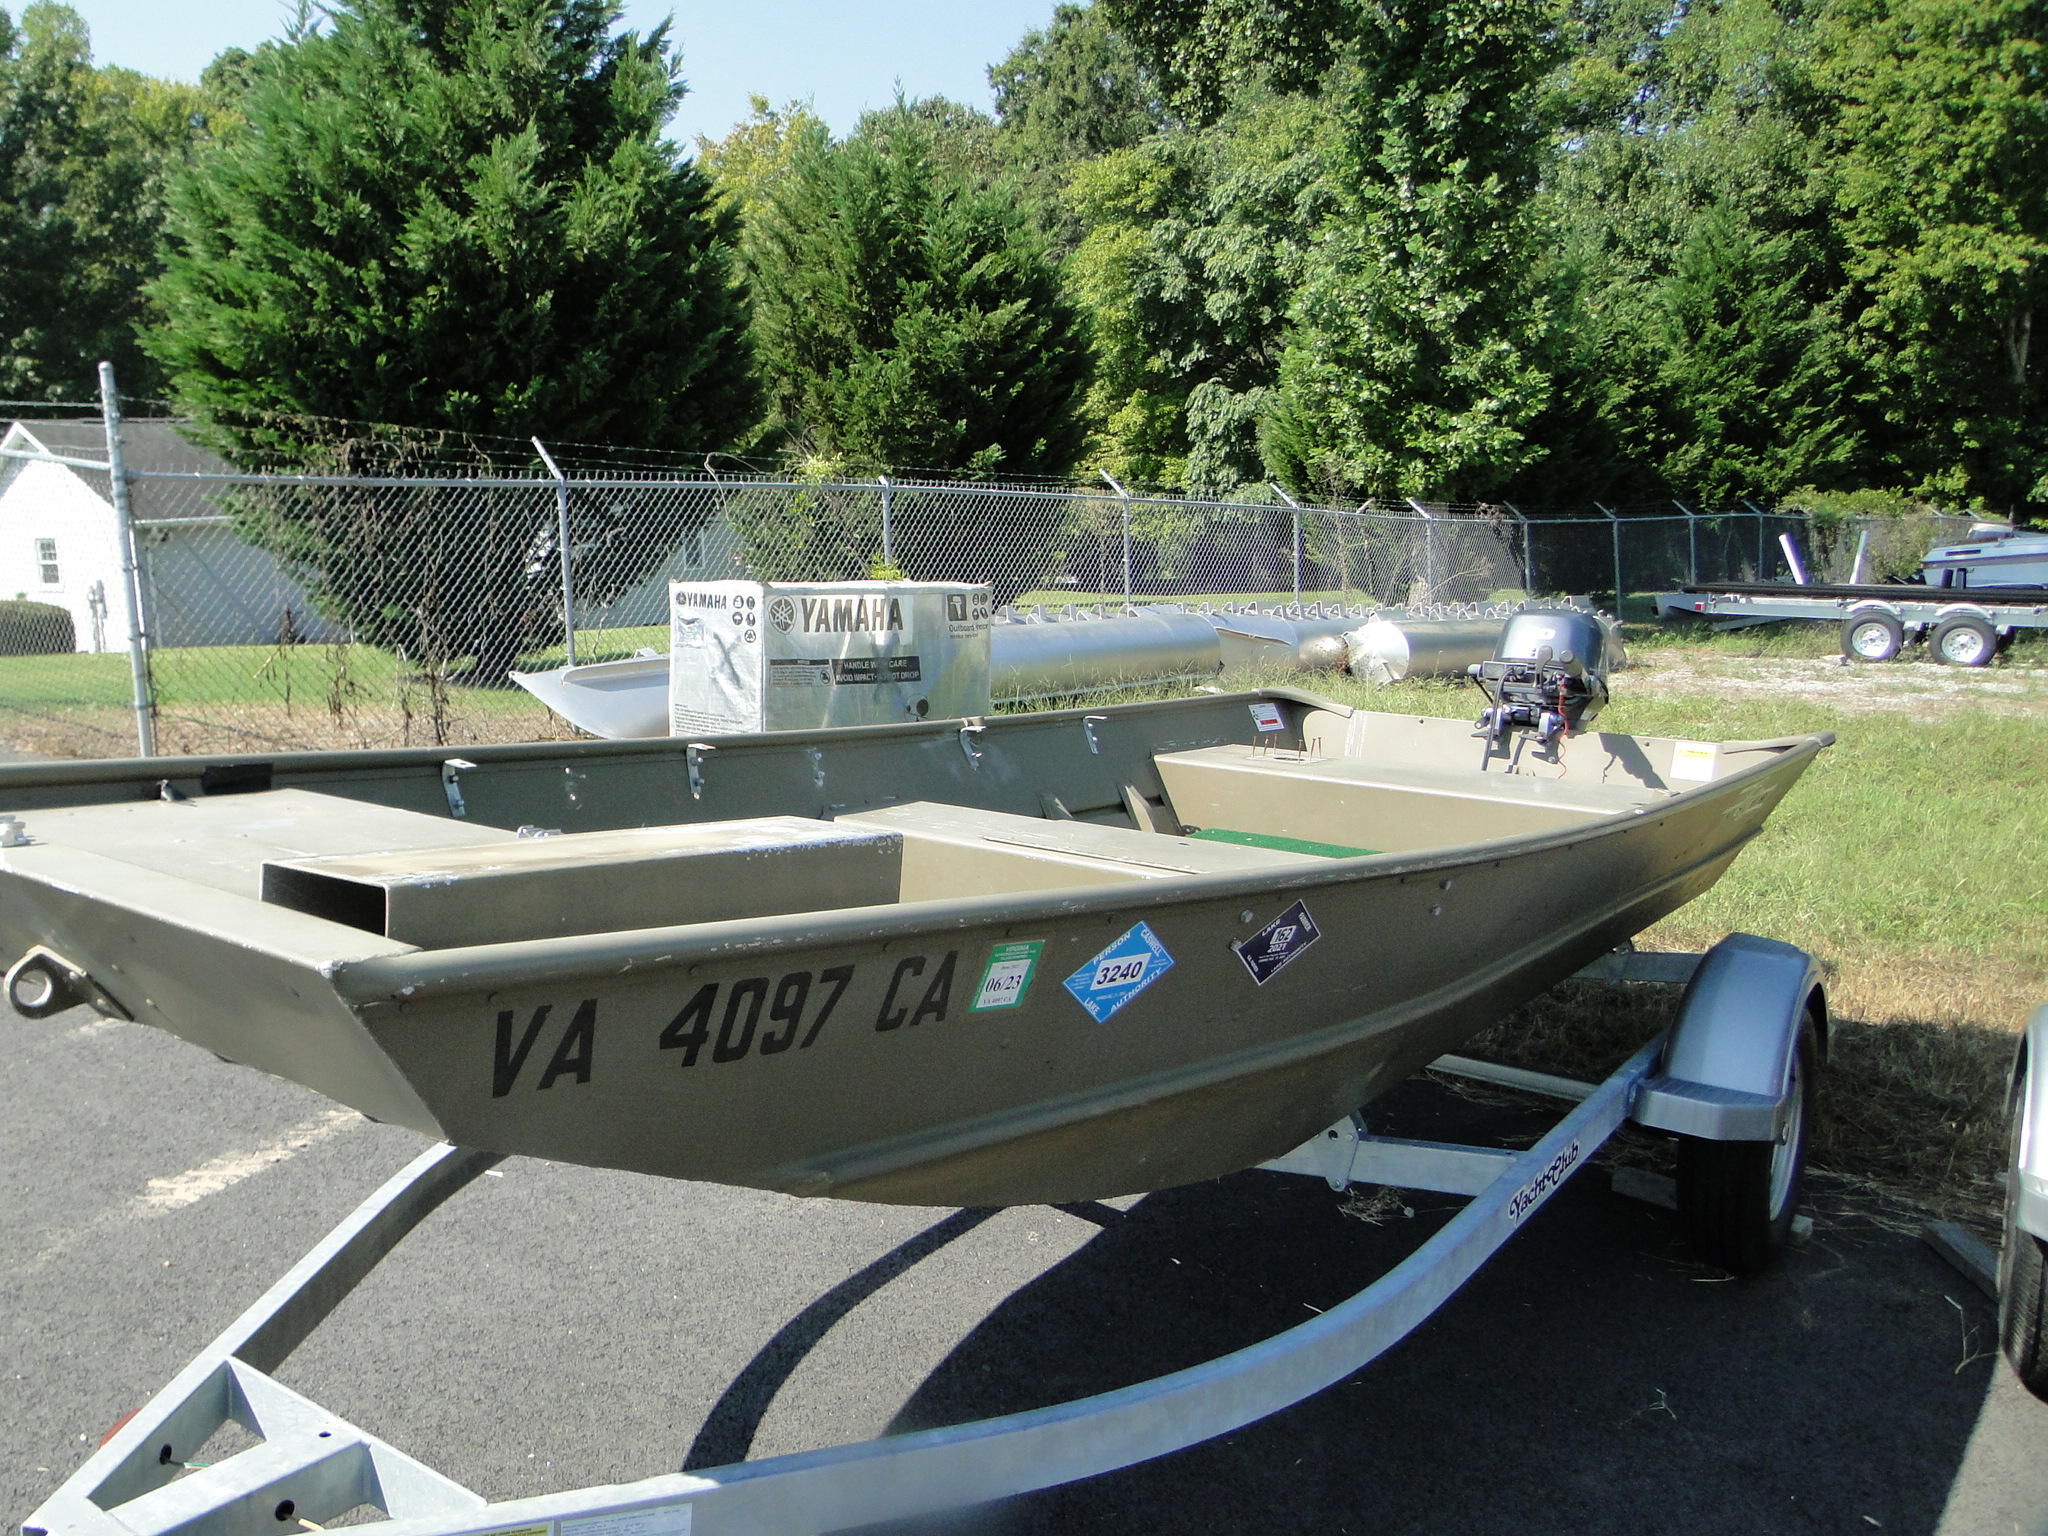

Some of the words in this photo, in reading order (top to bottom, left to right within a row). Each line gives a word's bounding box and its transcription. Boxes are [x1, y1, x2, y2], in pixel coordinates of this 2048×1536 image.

[687, 592, 727, 609] YAMAHA
[801, 598, 904, 633] YAMAHA
[843, 660, 870, 670] HANDLE
[888, 659, 907, 668] CARE
[900, 671, 920, 679] DROP
[1093, 931, 1131, 966] PERSON
[1140, 929, 1162, 957] CASWELL
[985, 974, 1022, 993] 06/23
[1096, 961, 1143, 985] 3240
[1110, 967, 1163, 1014] AUTHORITY
[1084, 997, 1100, 1016] LAKE
[492, 998, 597, 1099] VA
[659, 964, 855, 1068] 4097
[875, 951, 958, 1032] CA
